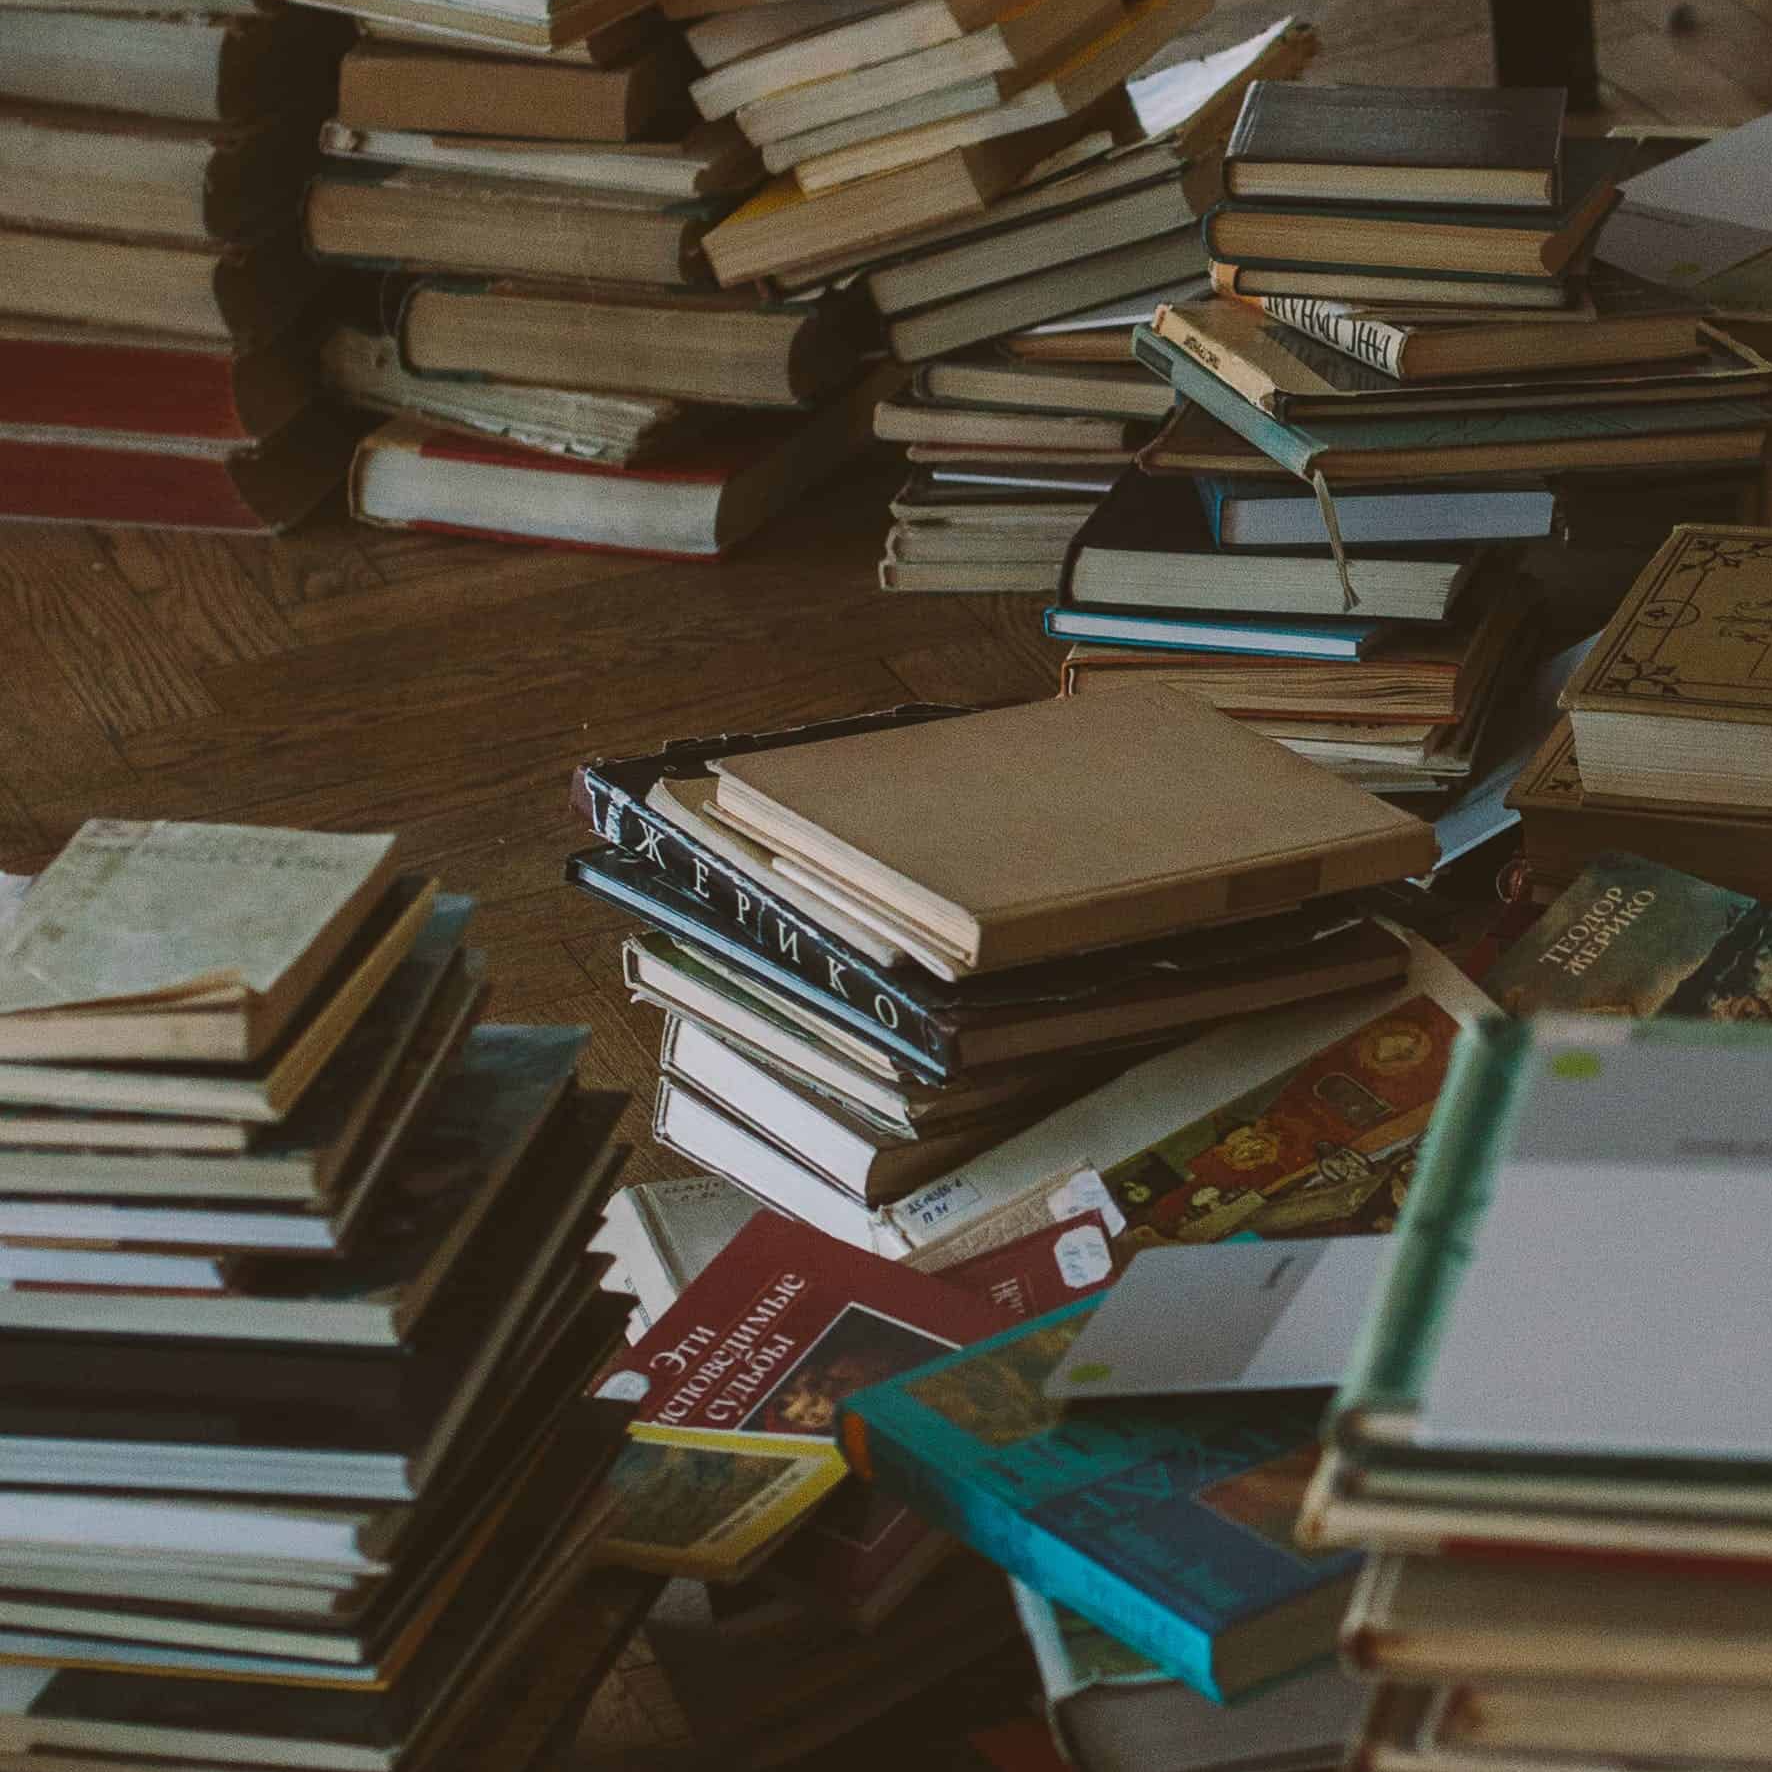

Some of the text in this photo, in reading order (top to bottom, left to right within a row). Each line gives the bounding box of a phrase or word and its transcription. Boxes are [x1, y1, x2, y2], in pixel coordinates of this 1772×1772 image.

[635, 818, 898, 1030] ЖЕРИКО
[1538, 886, 1622, 964] ТЕОДОР
[1563, 889, 1656, 976] ЖЕРИКО
[650, 1325, 716, 1374] Эти
[705, 1332, 796, 1421] судьбы
